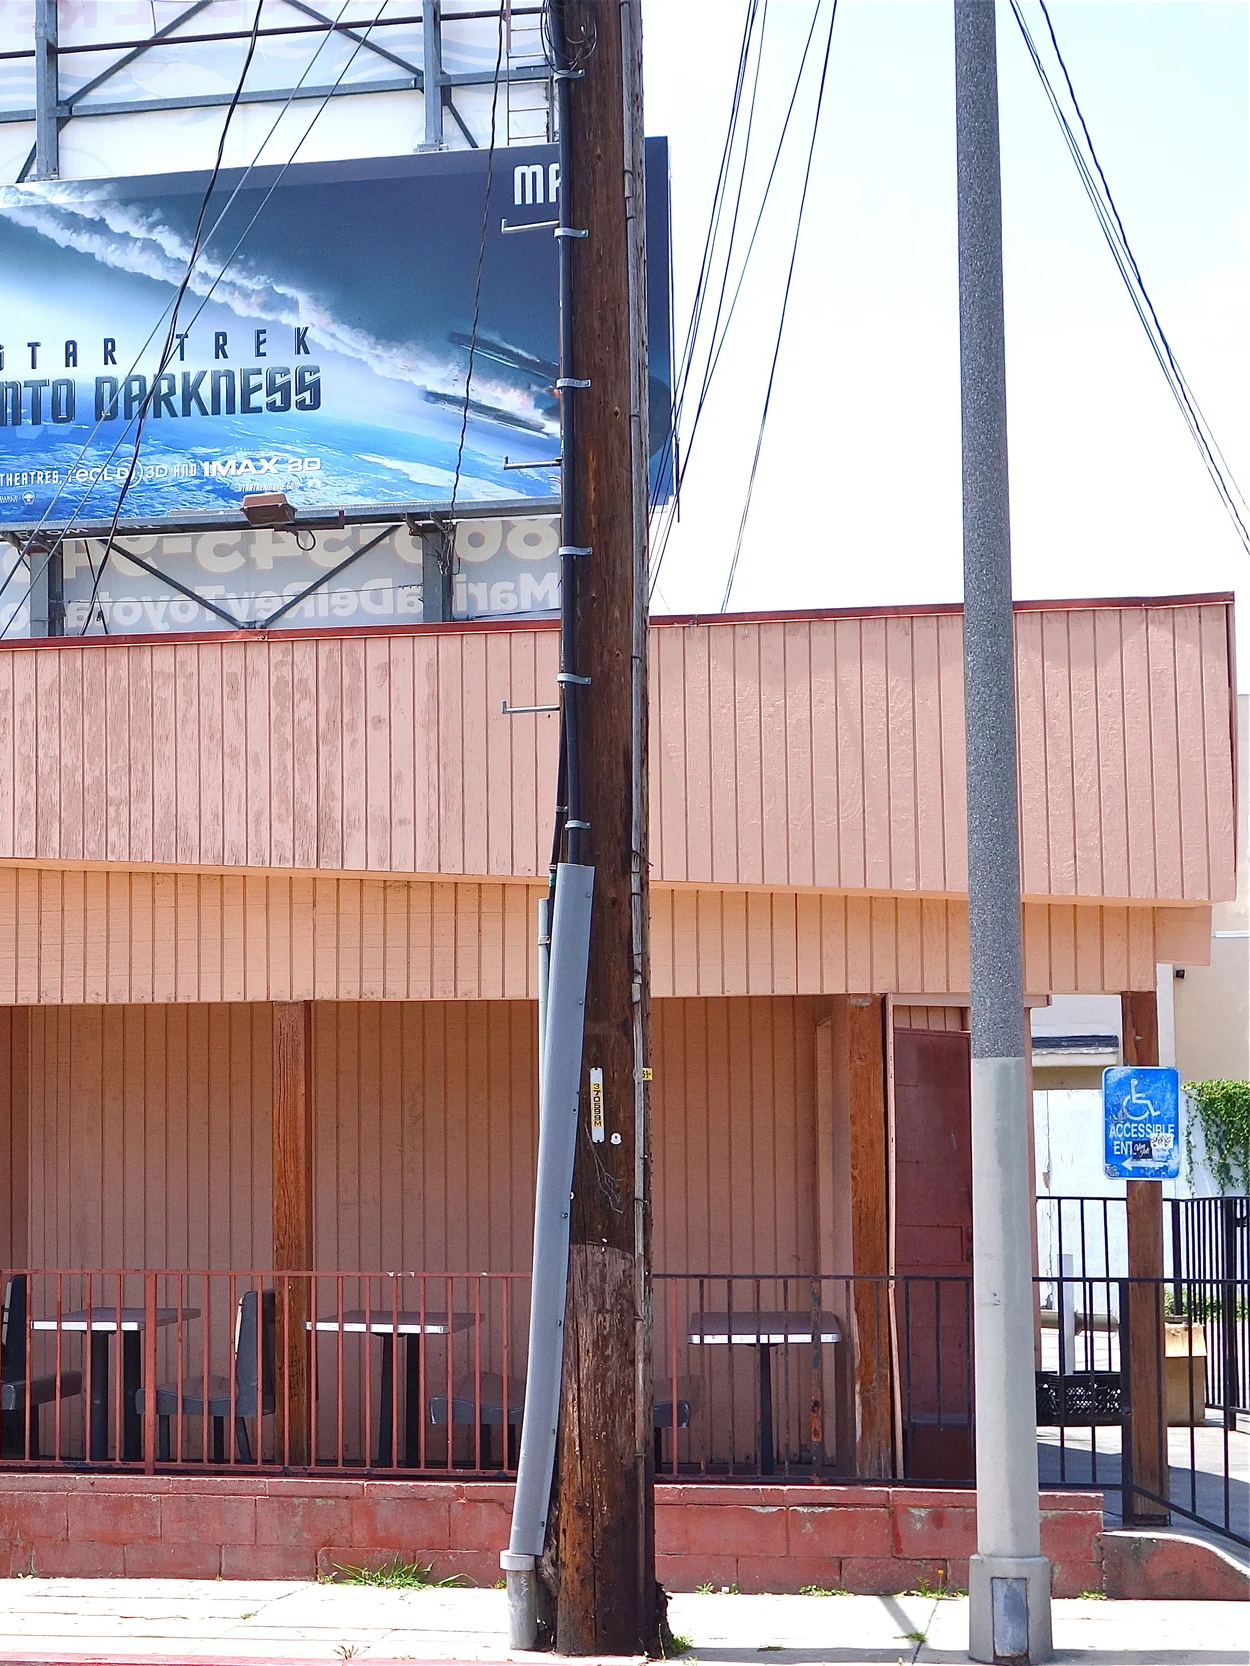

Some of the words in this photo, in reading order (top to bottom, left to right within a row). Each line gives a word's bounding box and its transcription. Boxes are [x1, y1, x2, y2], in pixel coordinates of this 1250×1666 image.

[175, 326, 311, 362] TREK
[93, 364, 323, 422] DARKNESS
[173, 462, 198, 478] AND
[202, 457, 280, 478] IMAX
[287, 457, 322, 473] 3D
[1108, 1123, 1176, 1138] ACCESSIBLE
